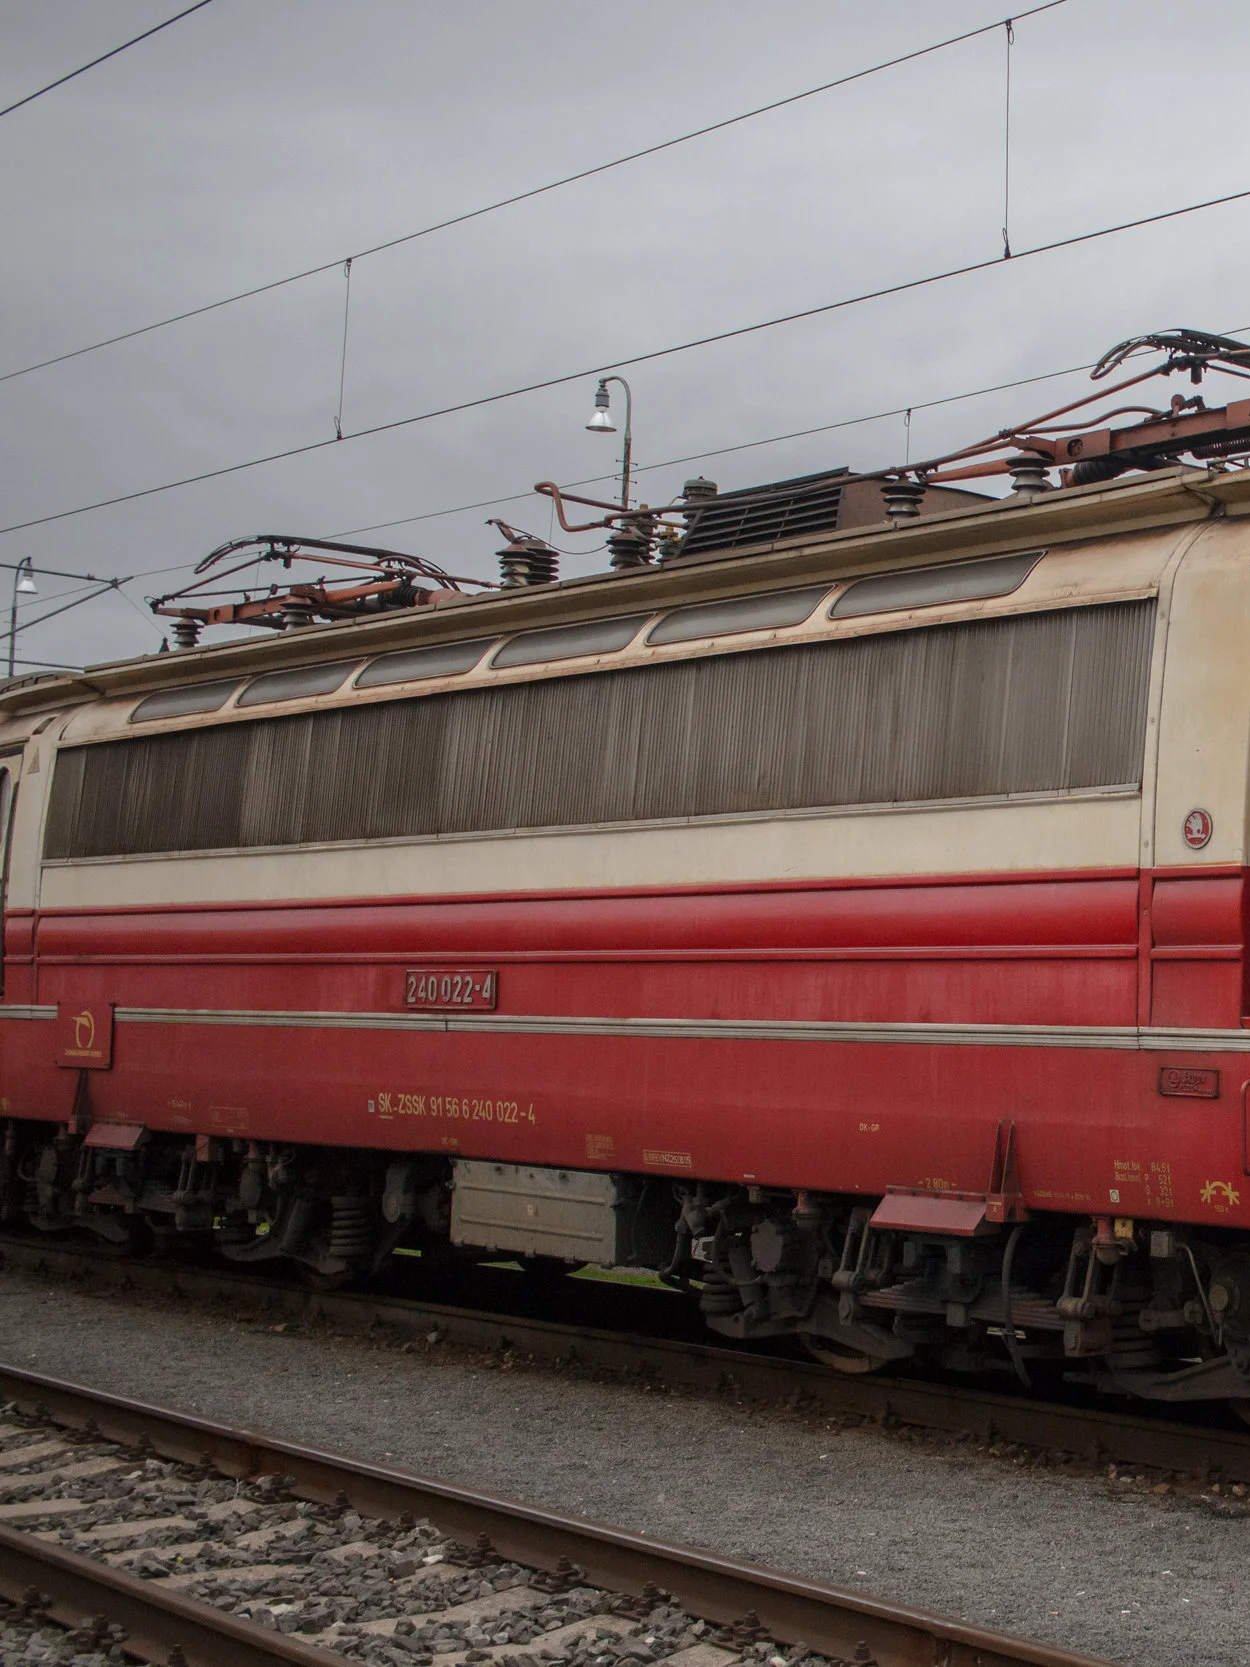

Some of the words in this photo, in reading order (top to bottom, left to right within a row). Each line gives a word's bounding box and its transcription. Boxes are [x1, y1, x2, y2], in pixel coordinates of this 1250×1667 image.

[407, 975, 437, 1003] 240
[430, 1096, 442, 1117] 91
[445, 1098, 459, 1119] 56
[462, 1099, 469, 1119] 6
[472, 1100, 493, 1122] 240
